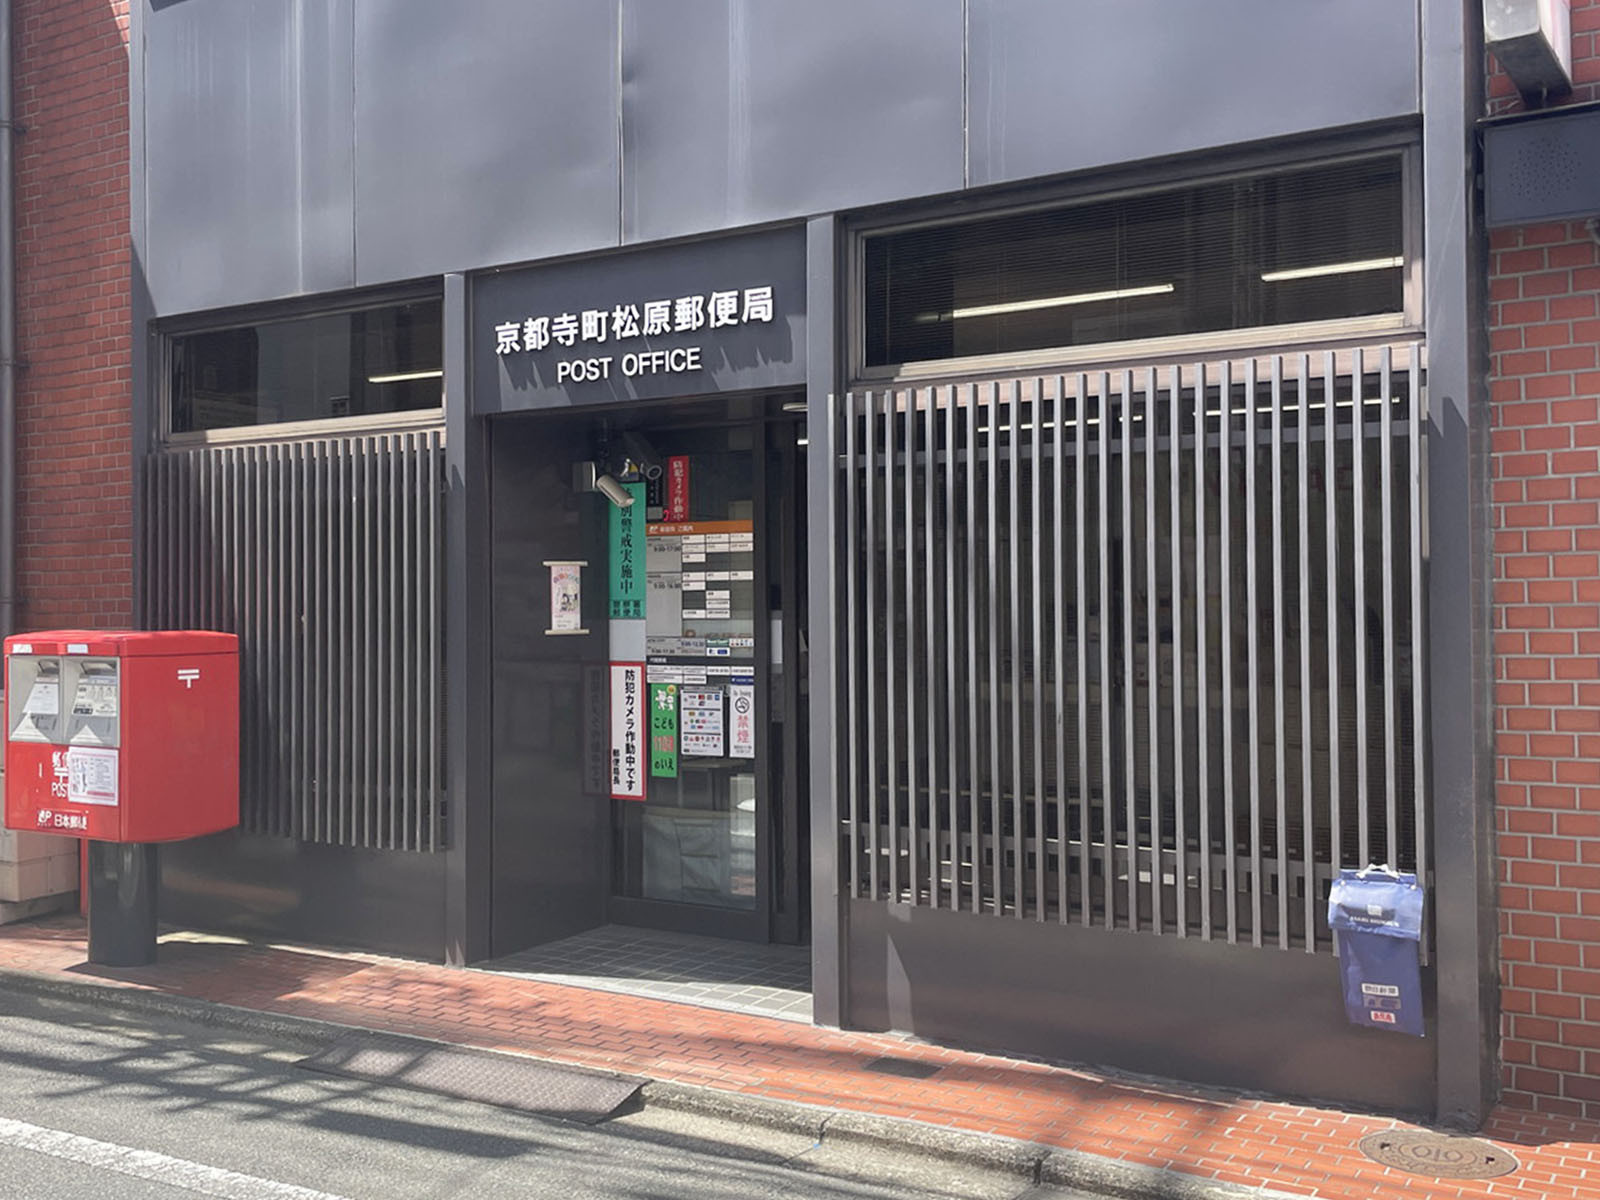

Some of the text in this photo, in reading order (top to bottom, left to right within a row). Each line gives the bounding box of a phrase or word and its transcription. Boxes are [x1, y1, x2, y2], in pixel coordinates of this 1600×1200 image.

[494, 286, 774, 356] 京都寺町松原郵便局
[557, 347, 702, 383] POST OFFICE
[625, 669, 636, 791] 防犯カメラ作動中です
[654, 717, 675, 730] こども
[737, 715, 750, 743] 禁煙
[654, 758, 674, 770] のいえ
